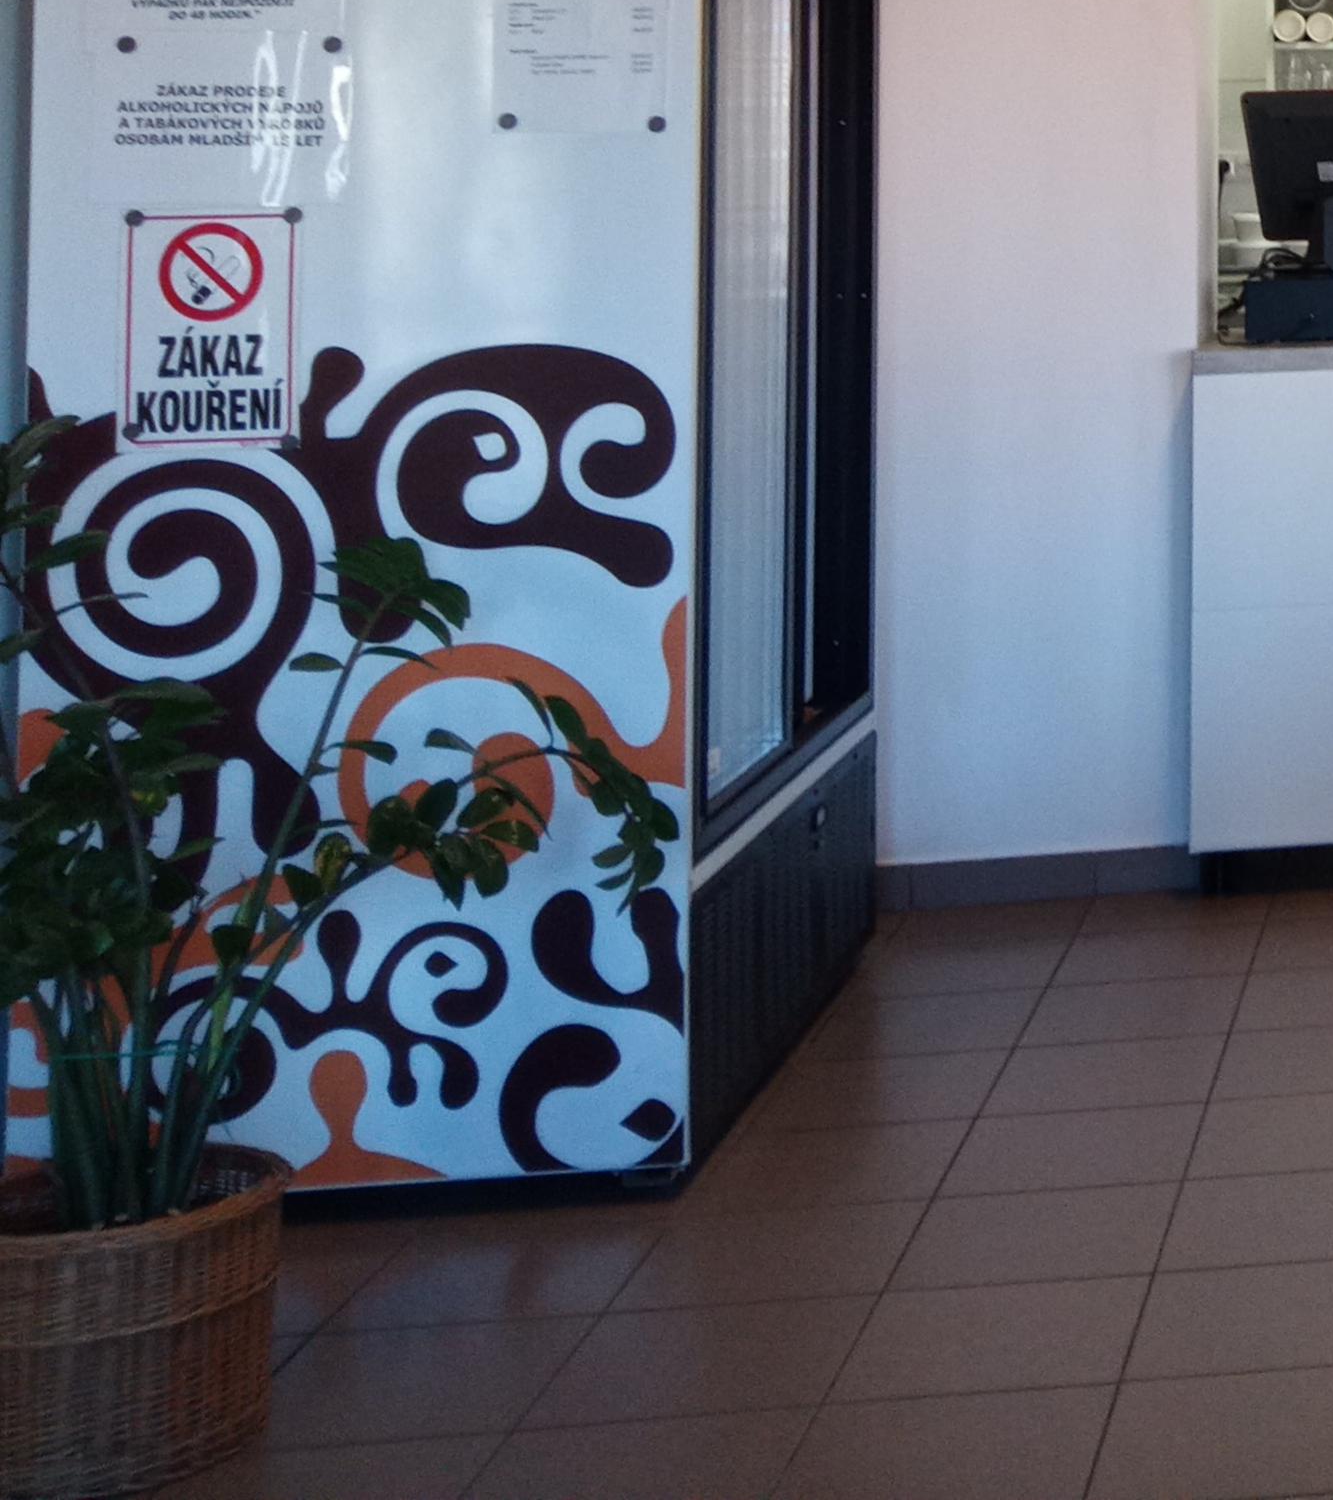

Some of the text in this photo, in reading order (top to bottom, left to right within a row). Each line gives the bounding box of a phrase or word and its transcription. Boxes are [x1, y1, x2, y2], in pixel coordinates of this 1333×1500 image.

[156, 84, 208, 97] ZÁKAZ
[117, 100, 253, 114] ALKOHOLICKÝCH
[118, 118, 130, 129] A
[134, 116, 243, 130] TABÁKOVÝCH
[296, 135, 324, 146] LET
[157, 326, 264, 378] ZÁKAZ
[136, 378, 284, 433] KOUŘENÍ
